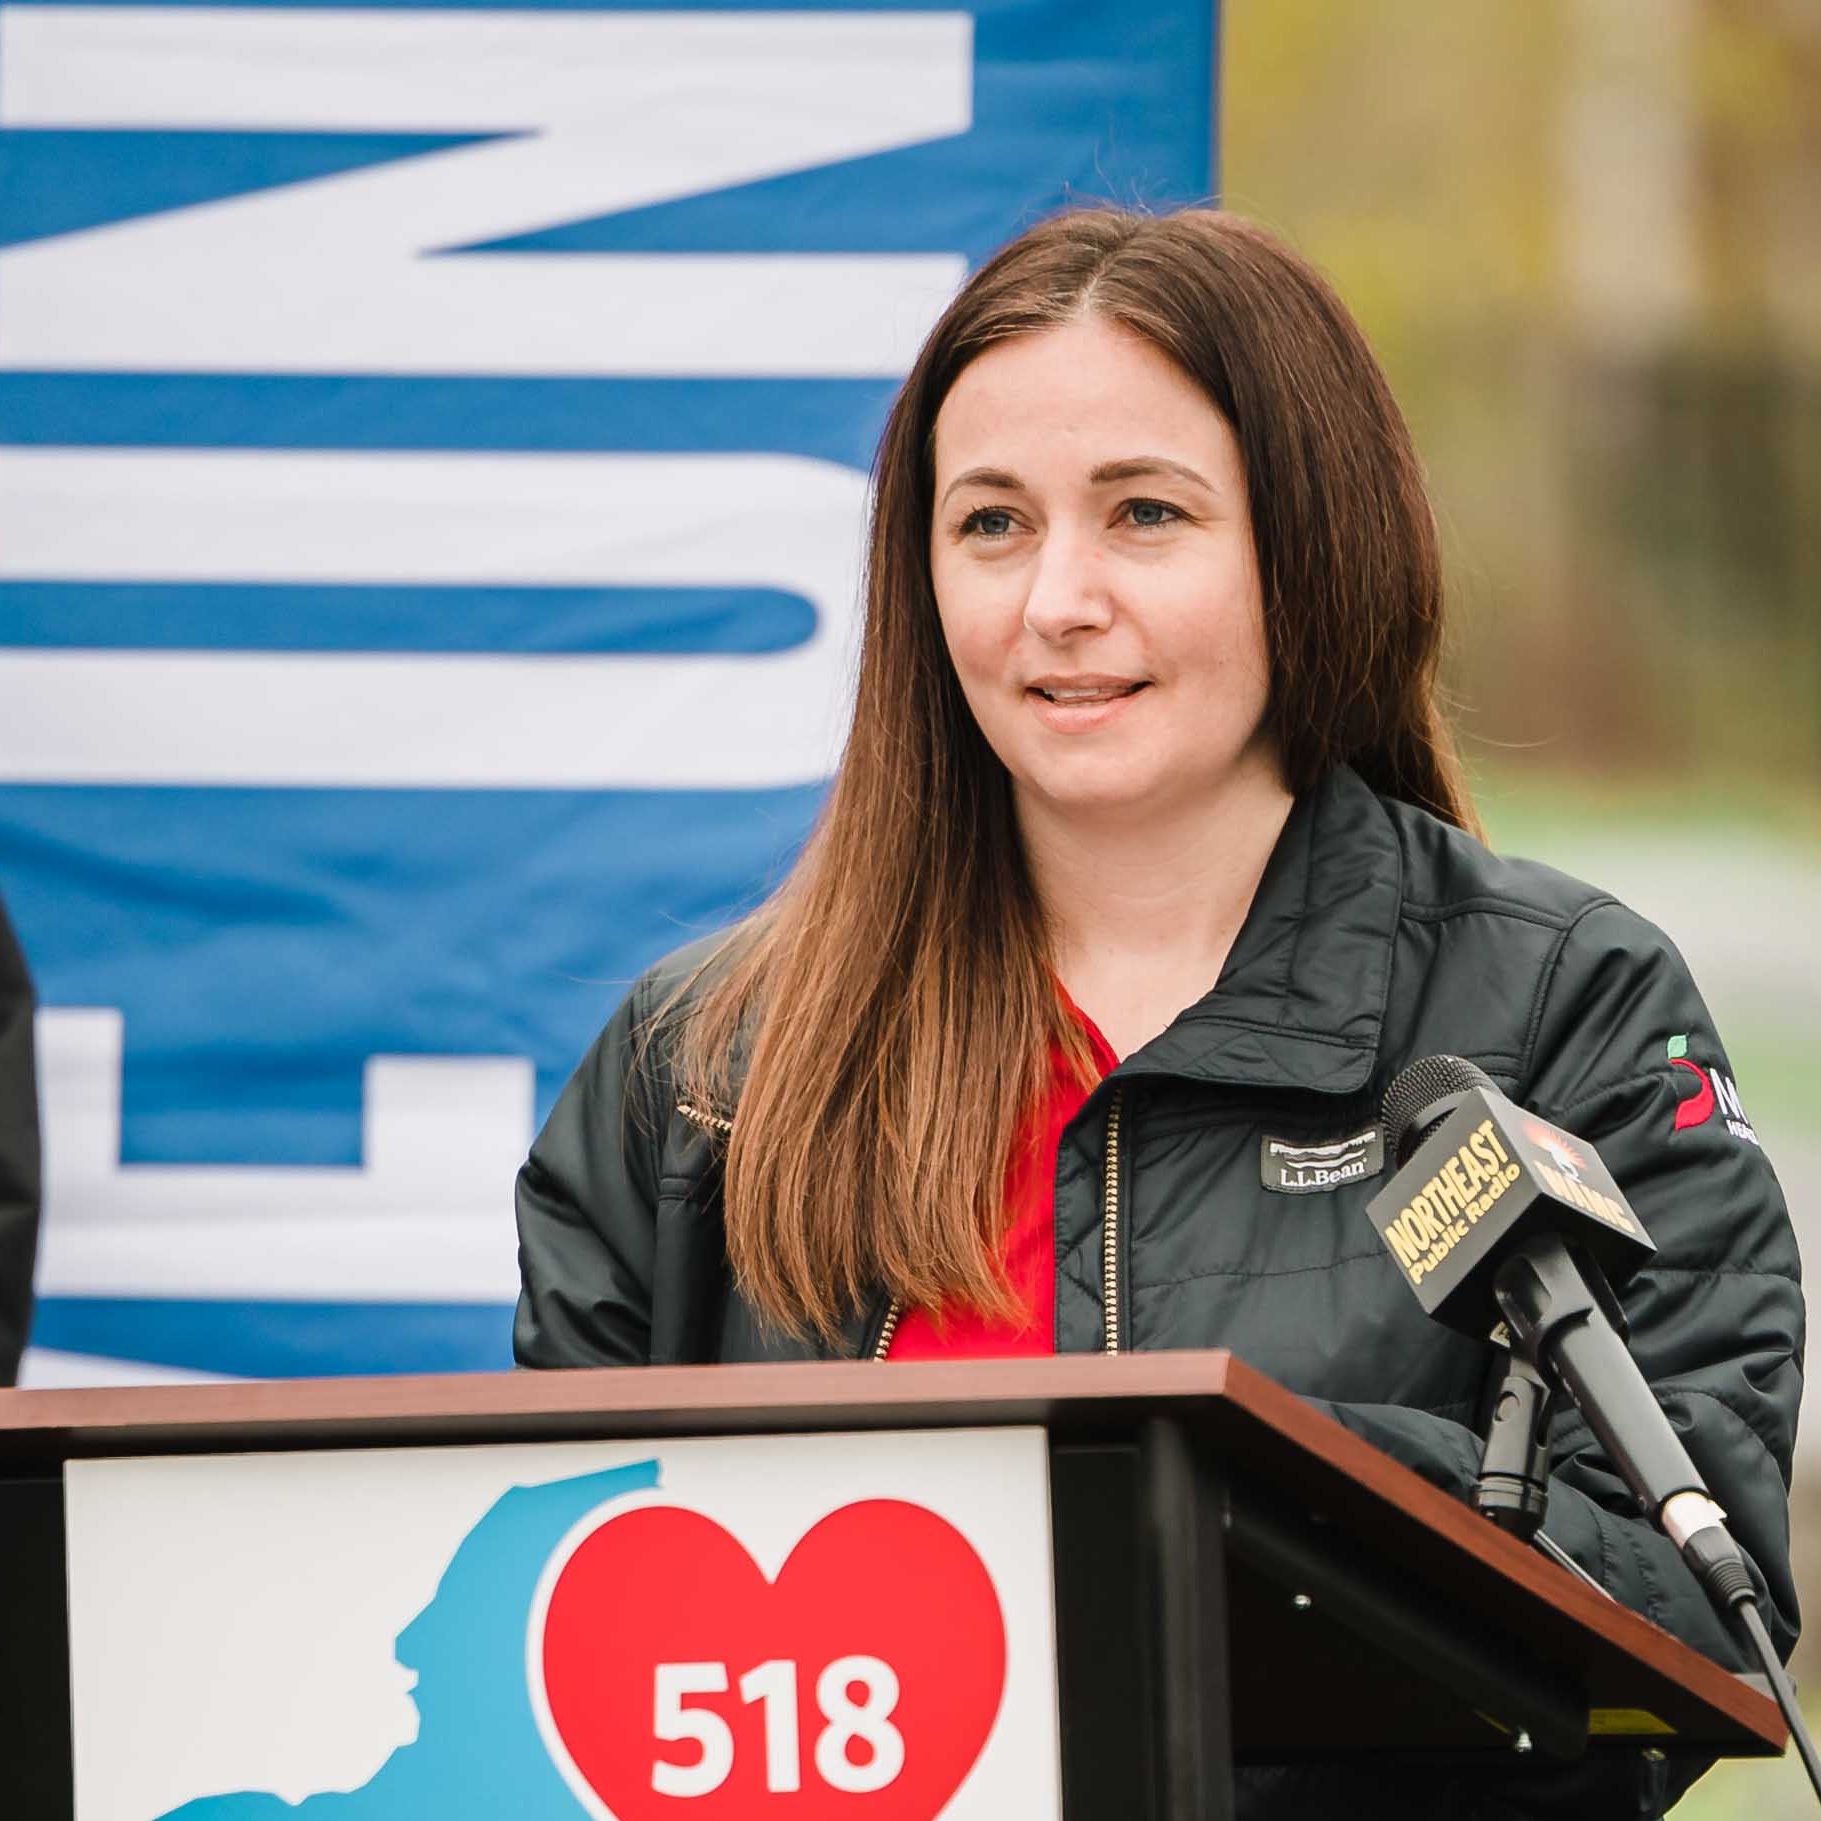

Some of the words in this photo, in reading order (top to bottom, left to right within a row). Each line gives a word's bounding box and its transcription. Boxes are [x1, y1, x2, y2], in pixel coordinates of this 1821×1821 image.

[1280, 1160, 1366, 1187] L.L.Bean
[1385, 1119, 1509, 1268] NORTHEAST
[1408, 1219, 1470, 1286] Public
[1464, 1162, 1521, 1224] Radio
[652, 1654, 906, 1798] 518
